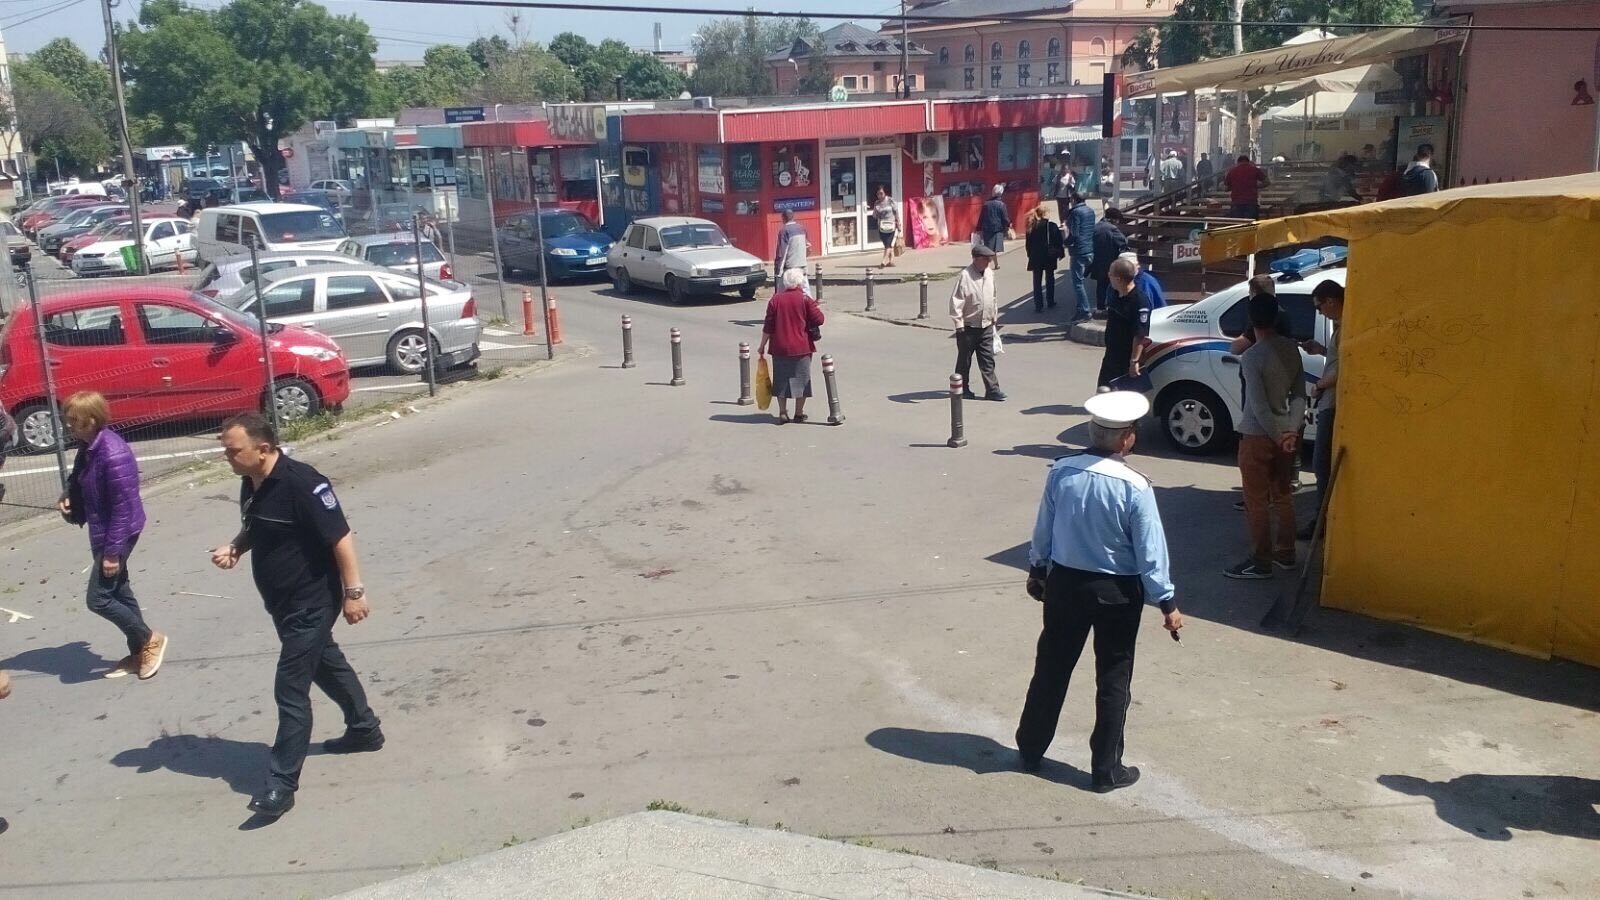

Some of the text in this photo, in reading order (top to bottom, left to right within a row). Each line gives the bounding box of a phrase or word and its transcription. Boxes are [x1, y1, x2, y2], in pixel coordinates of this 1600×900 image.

[1233, 38, 1348, 82] La Umbra
[733, 170, 761, 179] MARIS
[773, 200, 815, 210] SEVENTEEN
[1176, 245, 1201, 259] Buc
